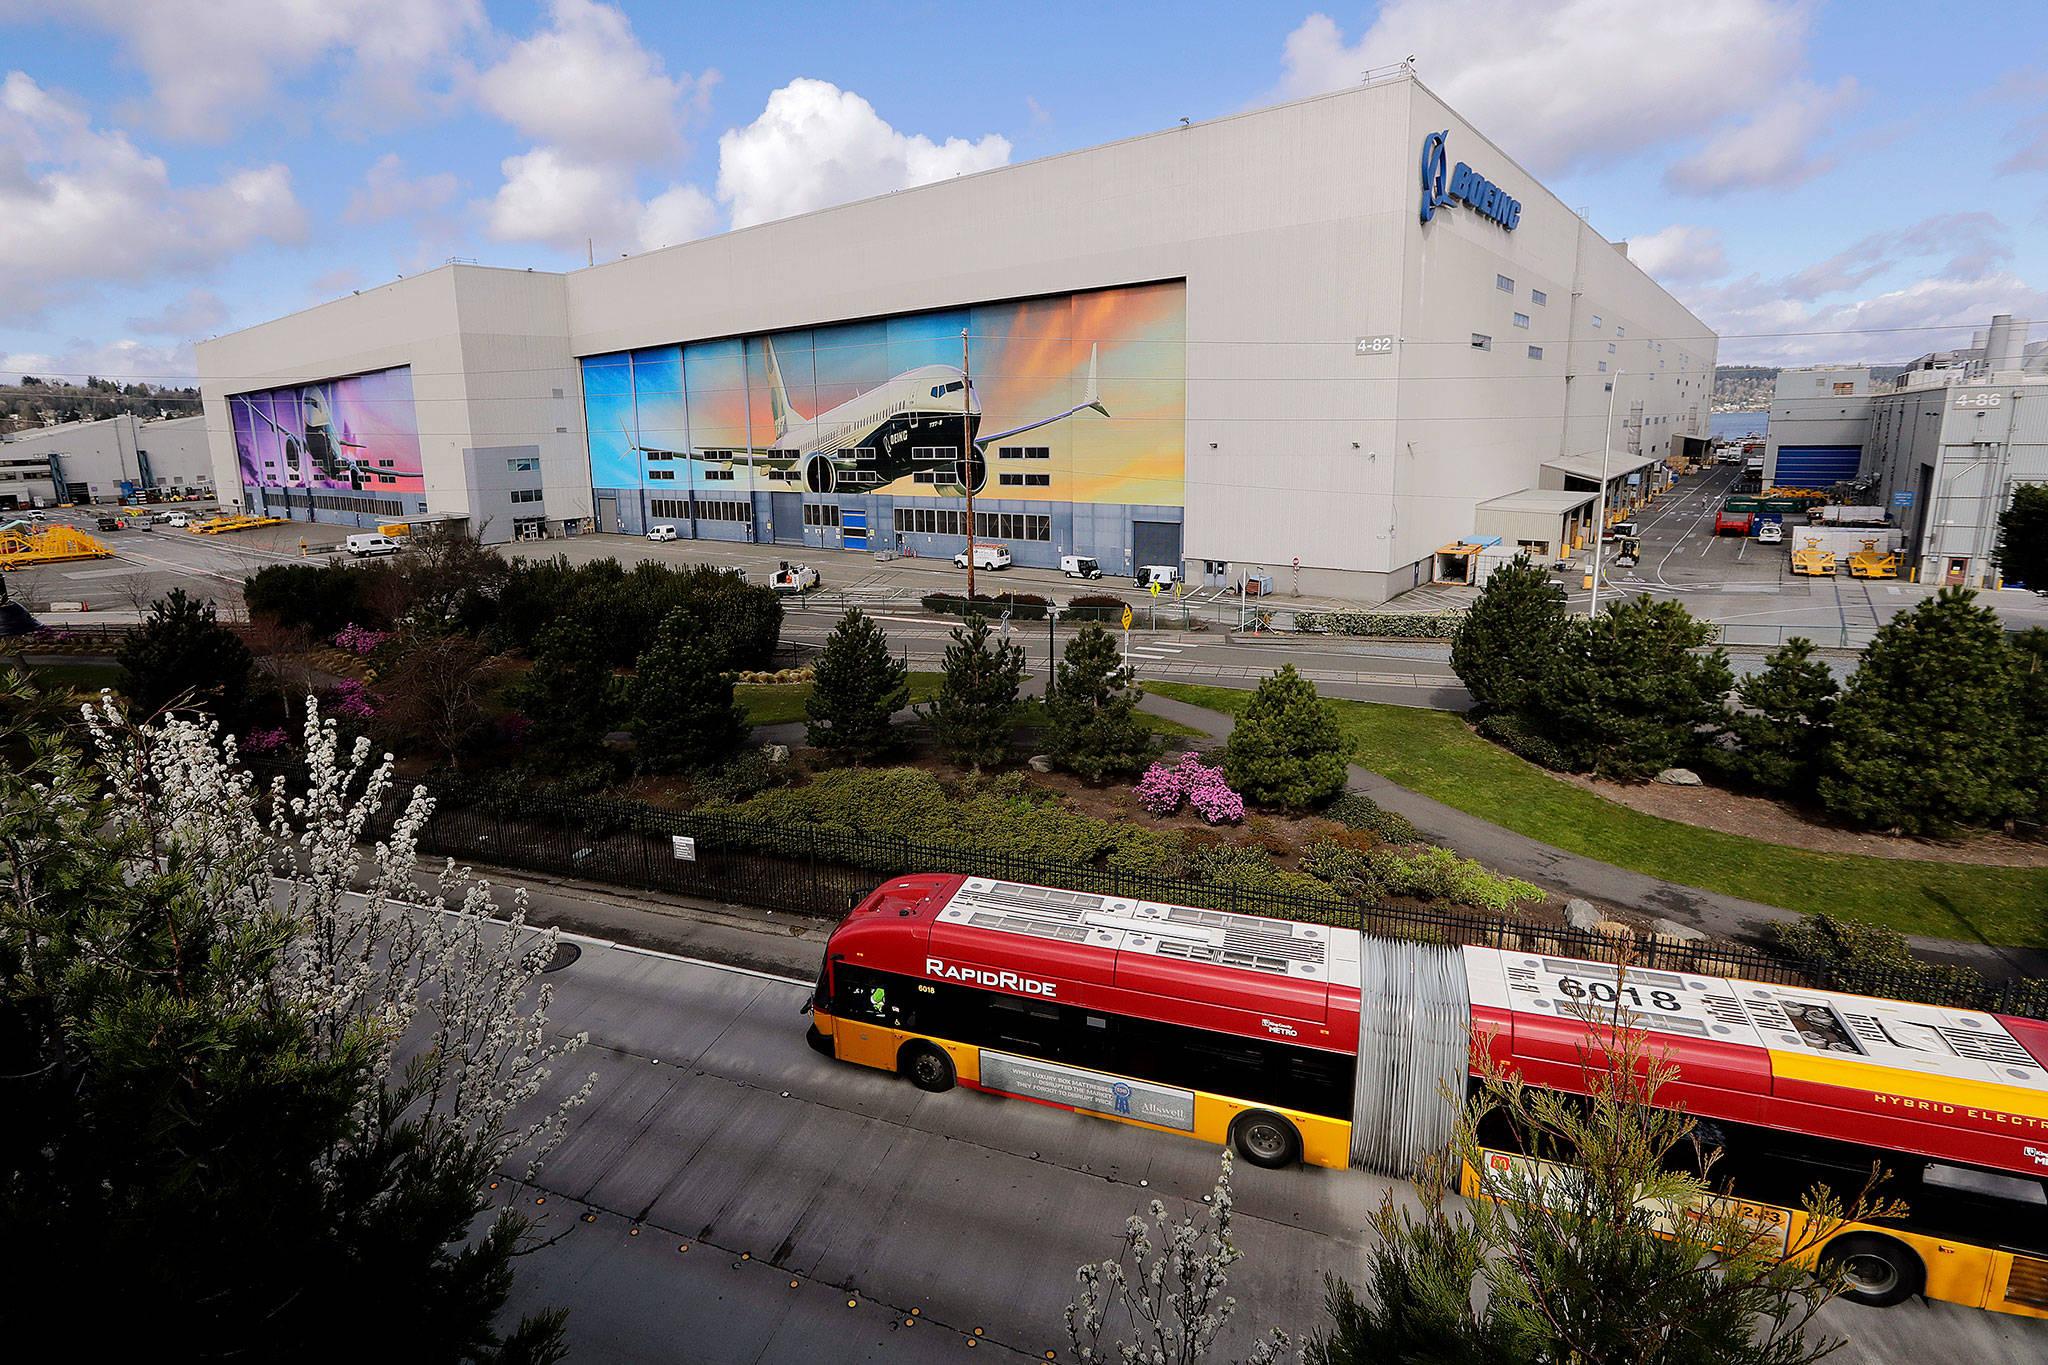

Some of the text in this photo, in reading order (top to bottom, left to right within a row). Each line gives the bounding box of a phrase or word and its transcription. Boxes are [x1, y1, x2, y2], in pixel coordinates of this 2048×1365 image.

[1449, 161, 1522, 232] BOEING
[1357, 337, 1391, 351] 4-82
[1955, 393, 2001, 406] 4-86
[926, 958, 1057, 997] RAPIDRIDE
[918, 984, 935, 994] 6018
[1558, 978, 1682, 1011] 6018
[1269, 1026, 1298, 1036] METRO
[1142, 1102, 1185, 1118] Allswell
[1874, 1094, 1955, 1114] HYBRID
